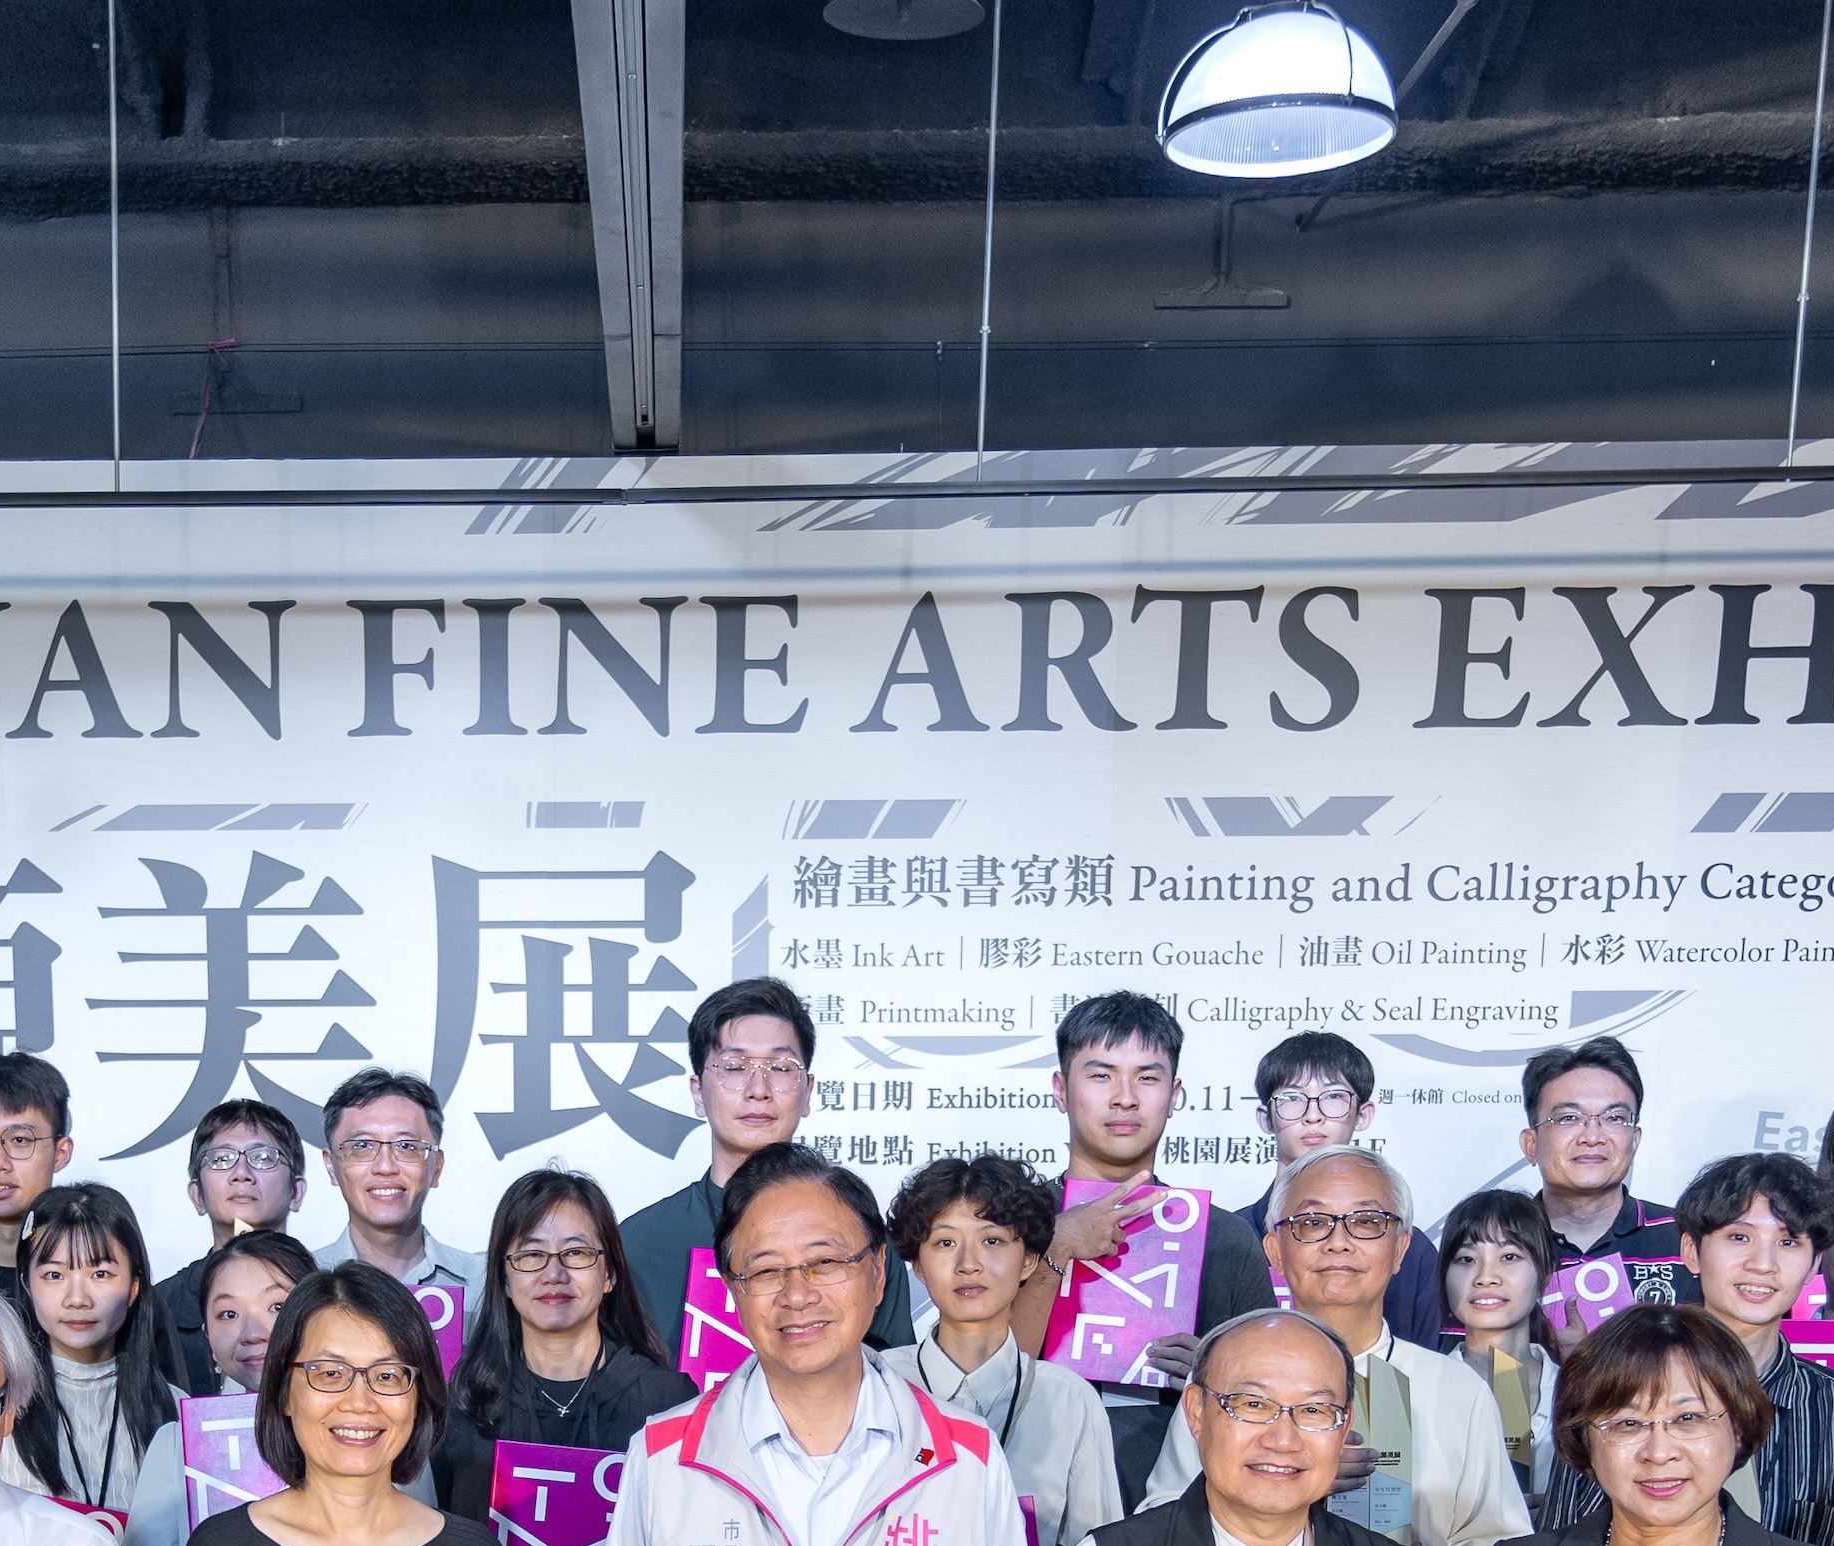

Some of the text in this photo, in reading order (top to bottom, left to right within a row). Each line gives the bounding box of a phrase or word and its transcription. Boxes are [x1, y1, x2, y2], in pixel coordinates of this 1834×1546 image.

[346, 592, 810, 740] FINE
[851, 584, 1361, 733] ARTS
[792, 854, 1117, 909] 繪畫與書寫類
[1129, 865, 1315, 913] Painting
[1332, 863, 1413, 902] and
[1426, 861, 1687, 914] Calligraphy
[781, 938, 945, 969] 水墨 Ink Art
[979, 937, 1264, 969] 膠彩 Eastern Gouache
[1299, 936, 1527, 972] 油畫 Oil Painting
[1561, 934, 1625, 966] 水彩
[1635, 938, 1775, 964] Watercolor
[799, 994, 1016, 1029] 畫 Printmaking
[1187, 997, 1336, 1031] Calligraphy
[1344, 1000, 1365, 1021] &
[1372, 997, 1423, 1022] Seal
[1431, 998, 1559, 1030] Engraving
[816, 1080, 913, 1111] 覽日期
[927, 1087, 1057, 1110] Exhibition
[1452, 1089, 1500, 1104] Closed
[793, 1136, 913, 1166] 覽地點
